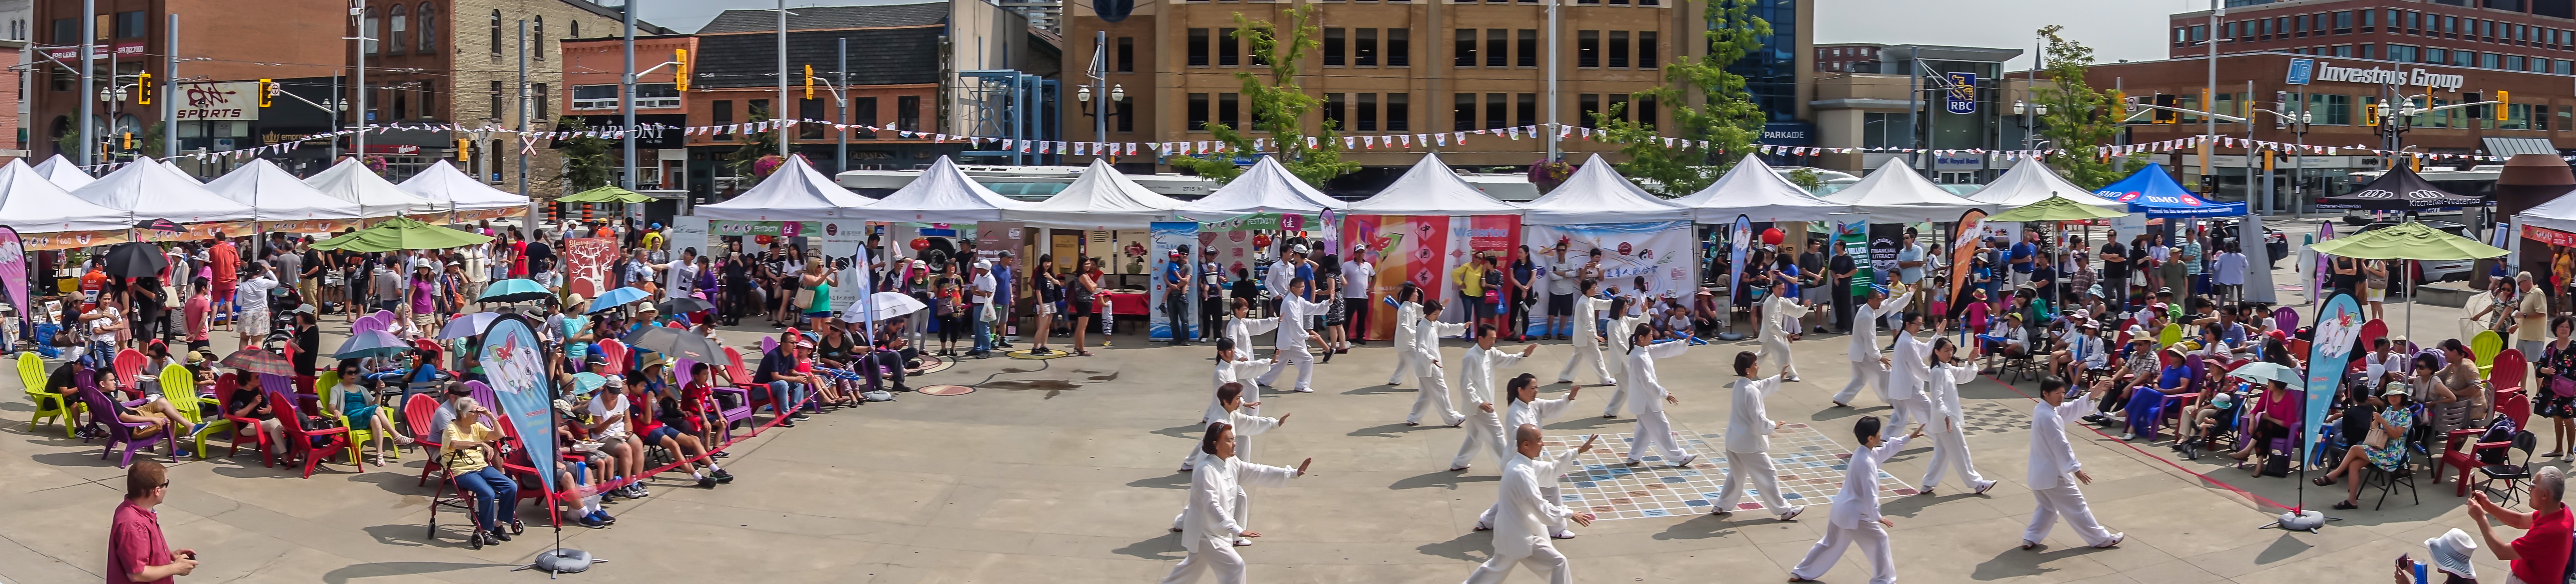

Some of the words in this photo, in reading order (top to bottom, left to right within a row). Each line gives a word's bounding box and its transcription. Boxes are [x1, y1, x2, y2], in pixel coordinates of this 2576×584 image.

[2317, 62, 2407, 85] Investors
[2410, 68, 2464, 92] Group
[1951, 101, 1973, 110] RBC
[177, 109, 242, 118] SPORTS
[850, 150, 889, 159] GUINNESS
[2409, 199, 2480, 207] Kitchener-Waterloo
[1247, 218, 1272, 226] FESTIVITY
[1453, 227, 1508, 238] Waterloo
[1469, 239, 1507, 248] Chinese
[1872, 238, 1895, 246] NATIONAL
